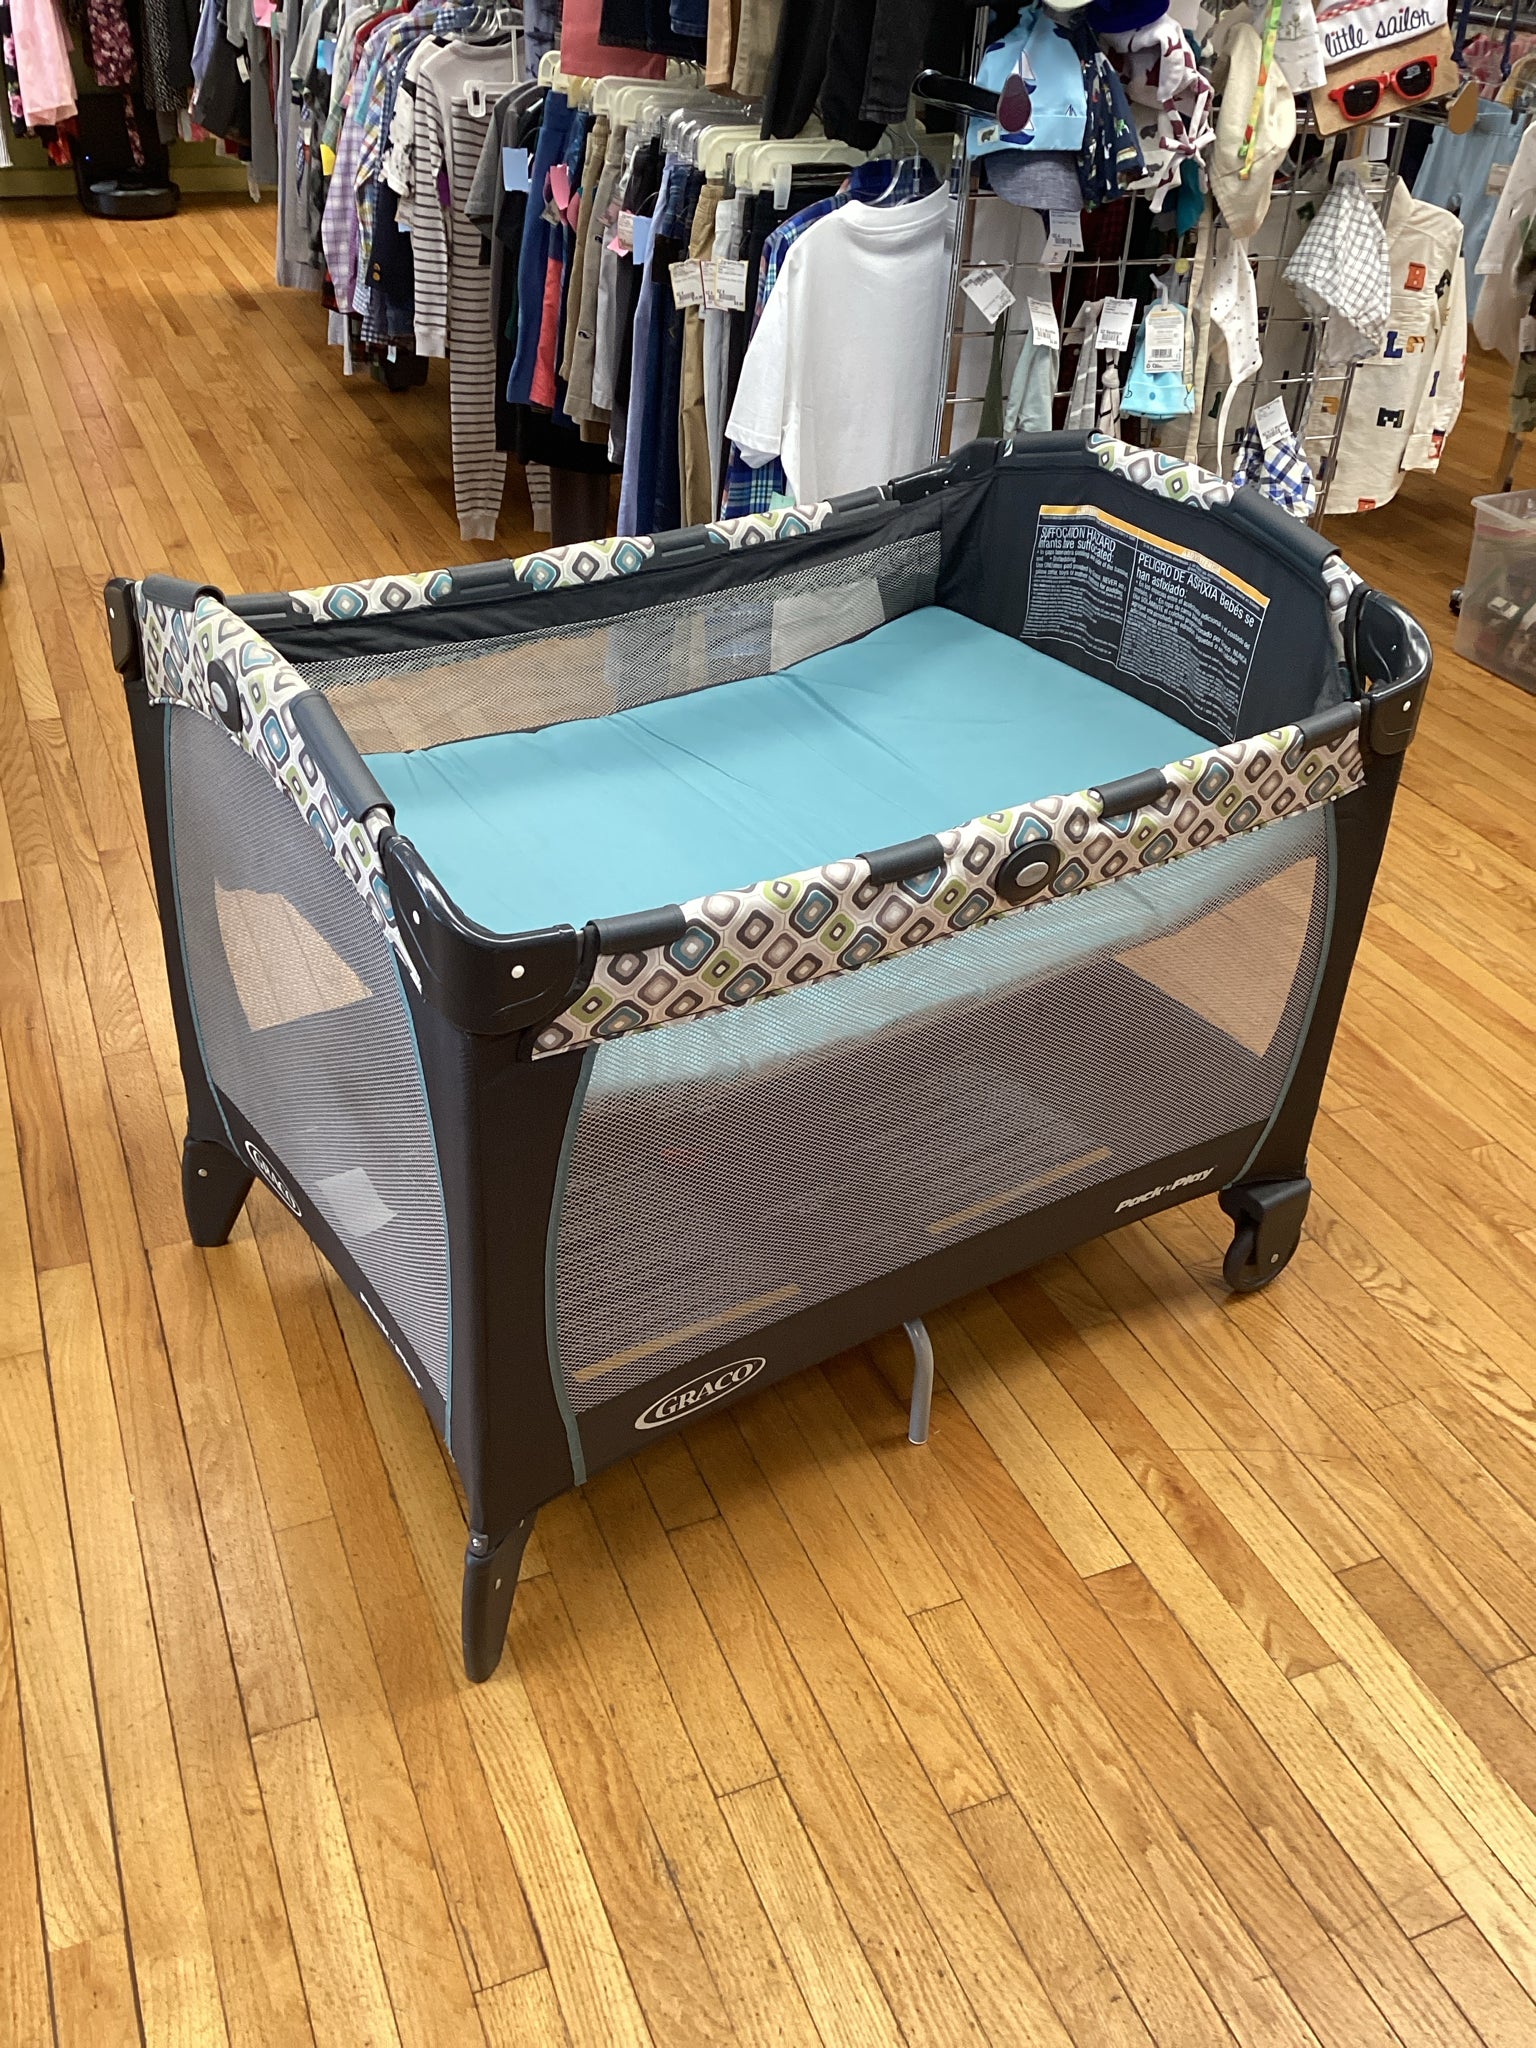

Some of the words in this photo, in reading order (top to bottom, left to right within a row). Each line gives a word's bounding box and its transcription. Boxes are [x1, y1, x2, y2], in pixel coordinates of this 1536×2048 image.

[1325, 24, 1369, 57] little
[1375, 6, 1436, 38] sailor
[1087, 528, 1116, 552] HAZARD
[1136, 566, 1150, 582] han
[1138, 553, 1172, 578] PELIGRO
[1173, 568, 1186, 583] DE
[1186, 574, 1219, 602] ASFIXIA
[1220, 592, 1243, 620] Bebés
[1244, 613, 1255, 628] se
[1114, 1186, 1164, 1213] Pack
[1170, 1167, 1214, 1191] Play
[656, 1363, 754, 1419] GRACO
